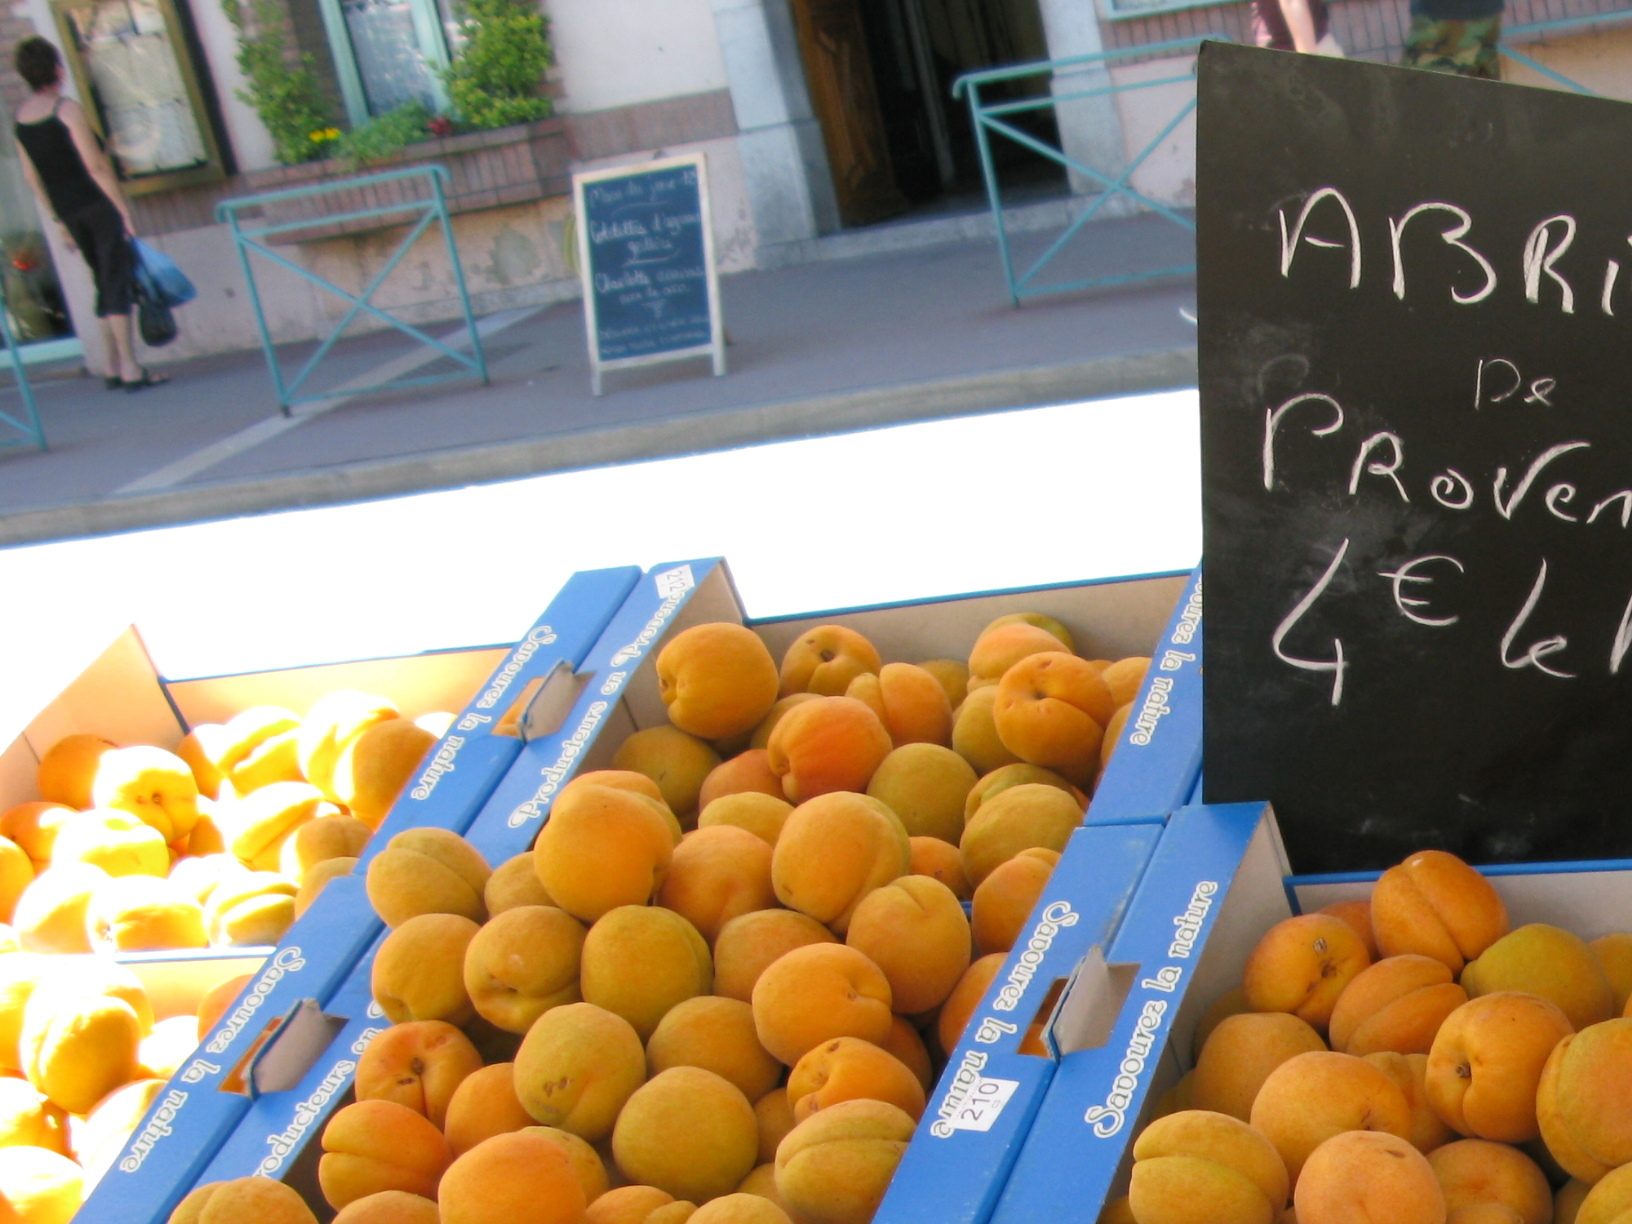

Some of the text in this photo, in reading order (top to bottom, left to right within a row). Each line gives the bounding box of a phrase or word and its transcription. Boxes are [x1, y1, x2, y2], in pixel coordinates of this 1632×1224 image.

[1130, 574, 1202, 746] ourez la nature
[1500, 559, 1577, 679] le
[410, 625, 557, 801] Savourez la nature
[507, 590, 686, 828] Producteurs en Provenc
[993, 901, 1078, 1014] Savourez
[1084, 881, 1219, 1139] Savourez la nature
[119, 946, 306, 1173] Savourez la nature
[961, 1082, 1000, 1121] 210
[975, 1015, 1017, 1051] la
[252, 1060, 356, 1178] roducteurs
